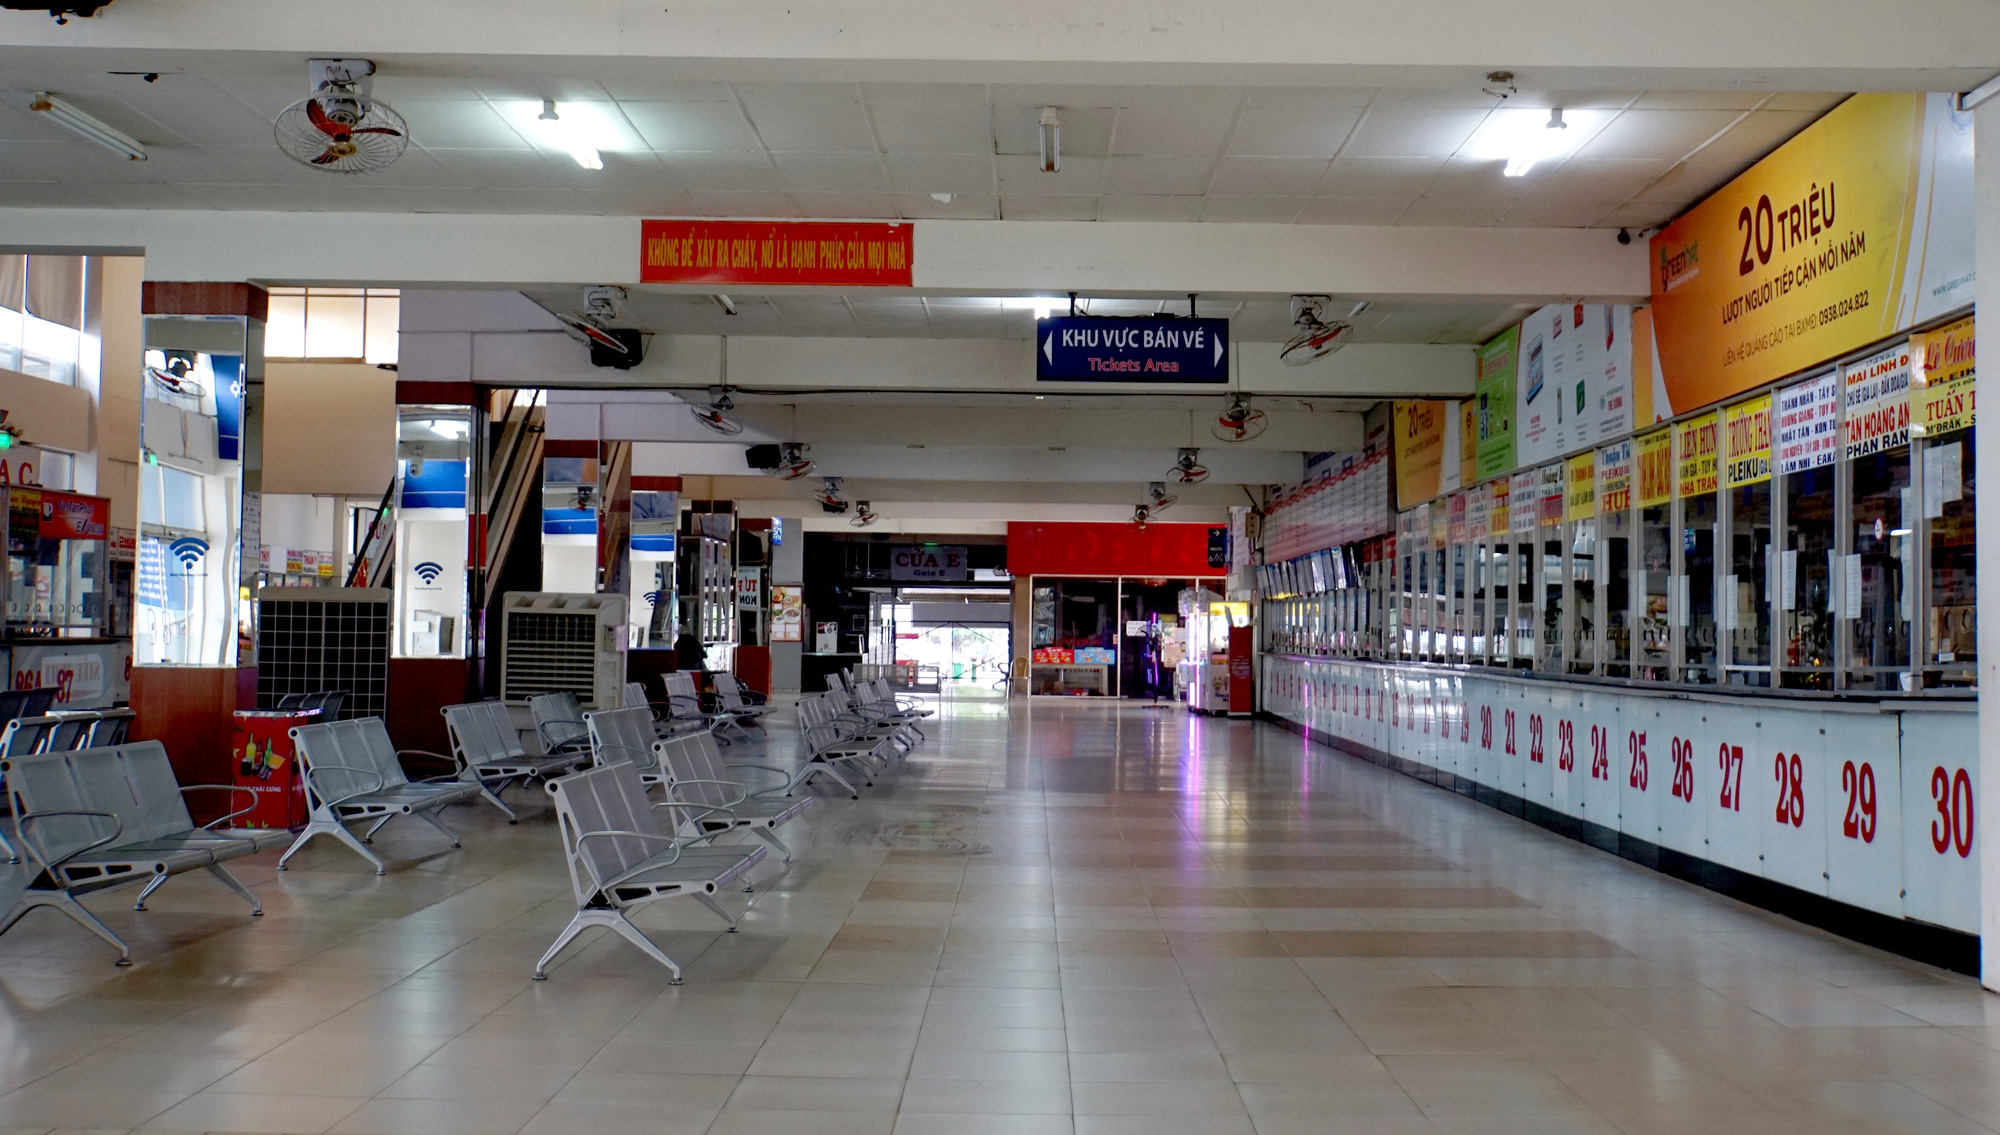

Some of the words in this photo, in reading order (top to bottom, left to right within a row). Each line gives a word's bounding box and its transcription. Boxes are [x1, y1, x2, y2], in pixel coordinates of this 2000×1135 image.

[1738, 194, 1773, 277] 20
[1777, 181, 1835, 253] TRIỆU
[648, 232, 679, 267] KHÔNG
[680, 227, 695, 267] ĐỂ
[696, 229, 714, 268] XẢY
[717, 238, 729, 269] RA
[761, 227, 776, 270] NỔ
[776, 234, 788, 269] LÀ
[791, 239, 816, 274] HẠNH
[820, 235, 844, 270] PHÚC
[847, 231, 865, 270] CỦA
[867, 240, 885, 276] MỌI
[887, 235, 906, 270] NHÀ
[1774, 265, 1795, 298] TIẾP
[1795, 257, 1817, 289] CẬN
[1818, 239, 1839, 276] MỖI
[1840, 230, 1866, 261] NĂM
[1062, 329, 1099, 347] KHU
[1102, 327, 1139, 352] VỰC
[1143, 326, 1179, 348] BÁN
[1182, 327, 1205, 349] VÉ
[1768, 325, 1784, 347] CÁO
[1818, 289, 1869, 326] 0938.024.822
[1088, 357, 1141, 372] Tickets
[1144, 358, 1179, 373] Area
[1847, 369, 1867, 386] MAI
[1870, 358, 1897, 378] LINH
[1818, 385, 1830, 401] TÂY
[1925, 389, 1964, 422] TUẤN
[1408, 404, 1419, 439] 20
[1798, 424, 1810, 439] TÂN
[1814, 421, 1827, 435] KON
[1845, 412, 1862, 445] TÂN
[1864, 402, 1896, 439] HOÀNG
[1781, 460, 1797, 474] LÂM
[1798, 457, 1811, 470] NHI
[1846, 437, 1879, 460] PHAN
[1601, 466, 1624, 481] PLEIKU
[1679, 478, 1695, 496] NHA
[1728, 457, 1758, 484] PLEIKU
[895, 547, 940, 568] CỬA
[946, 553, 961, 568] E
[56, 669, 74, 704] 87
[1423, 696, 1432, 734] 17
[1440, 697, 1450, 739] 18
[1459, 701, 1470, 744] 19
[1480, 704, 1493, 751] 20
[1504, 707, 1517, 756] 21
[1529, 713, 1544, 764] 22
[1558, 718, 1574, 773] 23
[1591, 723, 1609, 781] 24
[1628, 730, 1649, 792] 25
[1671, 735, 1694, 803] 26
[1719, 742, 1744, 812] 27
[1775, 752, 1805, 828] 28
[1842, 760, 1877, 844] 29
[1931, 766, 1974, 858] 30
